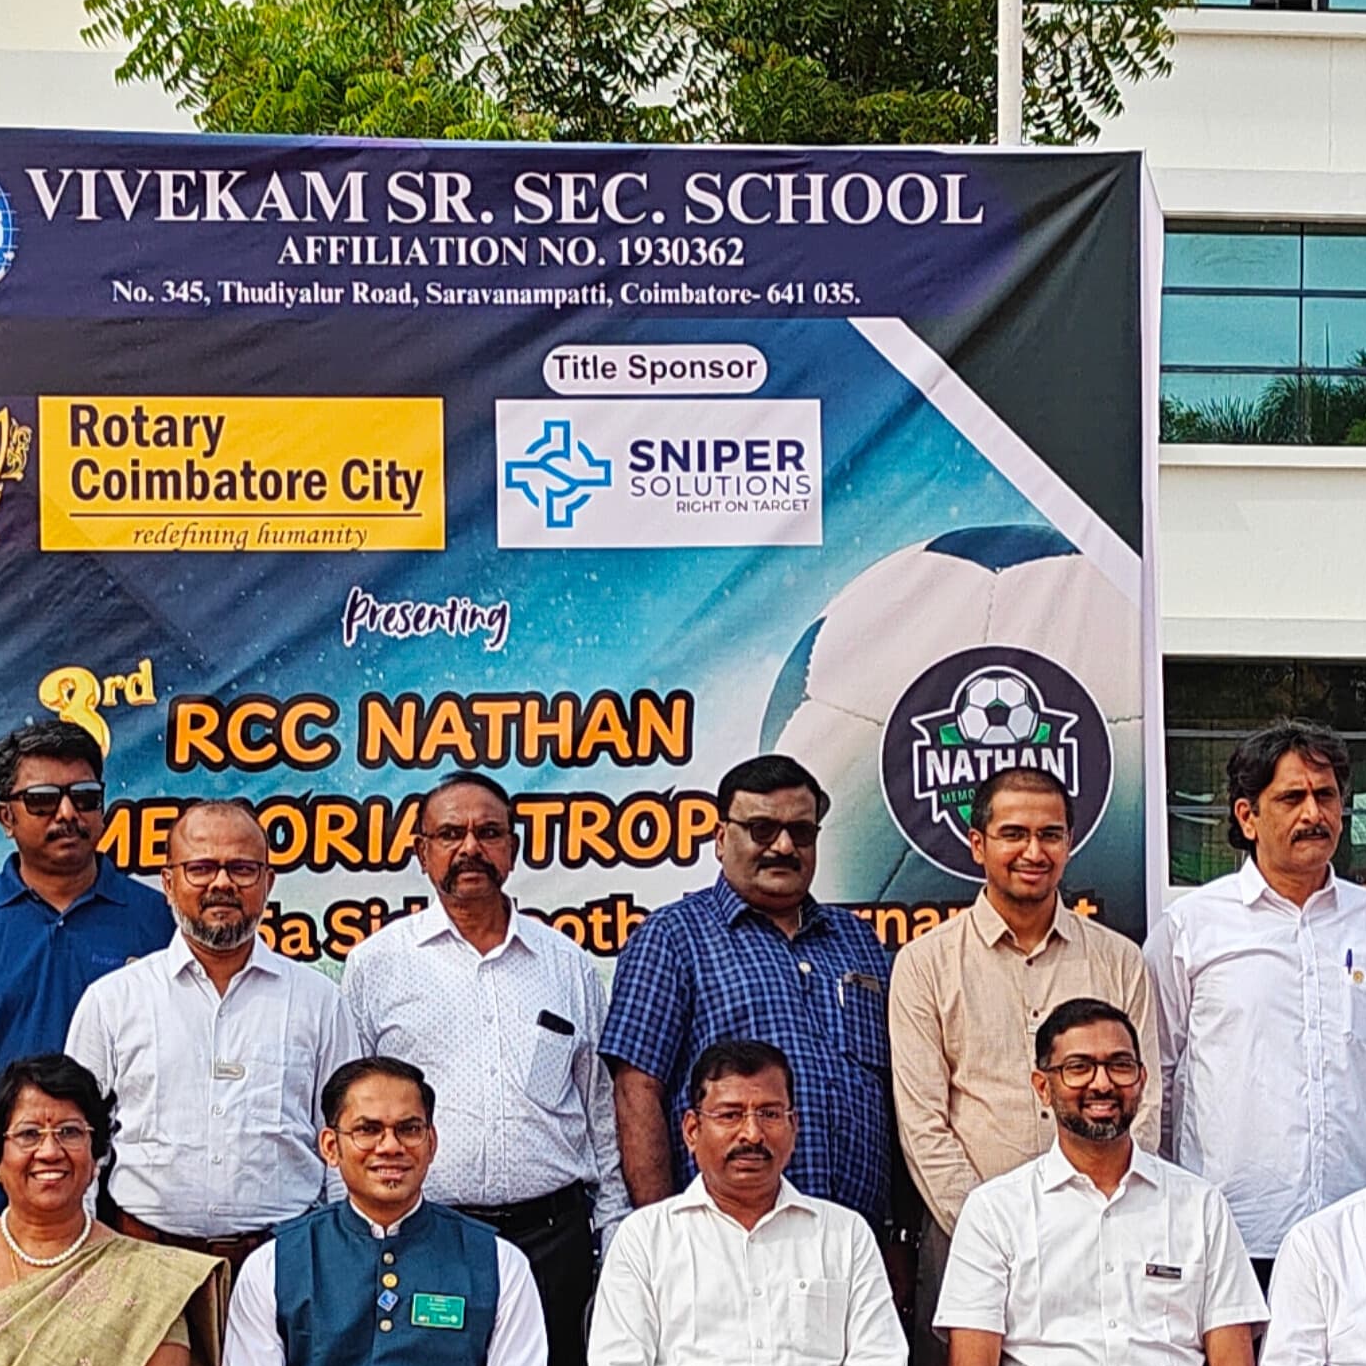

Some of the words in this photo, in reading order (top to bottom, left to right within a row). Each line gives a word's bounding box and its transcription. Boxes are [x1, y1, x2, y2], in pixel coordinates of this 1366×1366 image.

[24, 168, 370, 223] VIVEKAM
[387, 171, 494, 224] SR.
[514, 172, 665, 224] SEC.
[685, 172, 984, 225] SCHOOL
[277, 236, 527, 266] AFFILIATION
[539, 237, 606, 266] NO.
[618, 236, 744, 266] 1930362
[112, 280, 155, 302] No.
[161, 280, 211, 306] 345,
[217, 280, 345, 309] Thudiyalur
[352, 281, 420, 307] Road,
[426, 282, 614, 310] Saravanampatti,
[620, 282, 761, 304] Coimbatore-
[767, 282, 804, 304] 641
[813, 282, 861, 304] 035.
[553, 355, 617, 380] Title
[628, 355, 757, 387] Sponsor
[70, 404, 225, 453] Rotary
[628, 439, 805, 473] SNIPER
[71, 458, 327, 502] Coimbatore
[341, 458, 423, 511] City
[630, 475, 812, 497] SOLUTIONS
[676, 501, 721, 513] RIGHT
[725, 501, 748, 512] ON
[752, 499, 810, 512] TARGET
[134, 522, 249, 549] redefining
[257, 522, 367, 549] humanity
[175, 701, 332, 764] RCC
[366, 698, 687, 761] NATHAN
[926, 747, 1066, 787] NATHAN
[941, 788, 976, 803] MEMO
[516, 799, 720, 861] TROP
